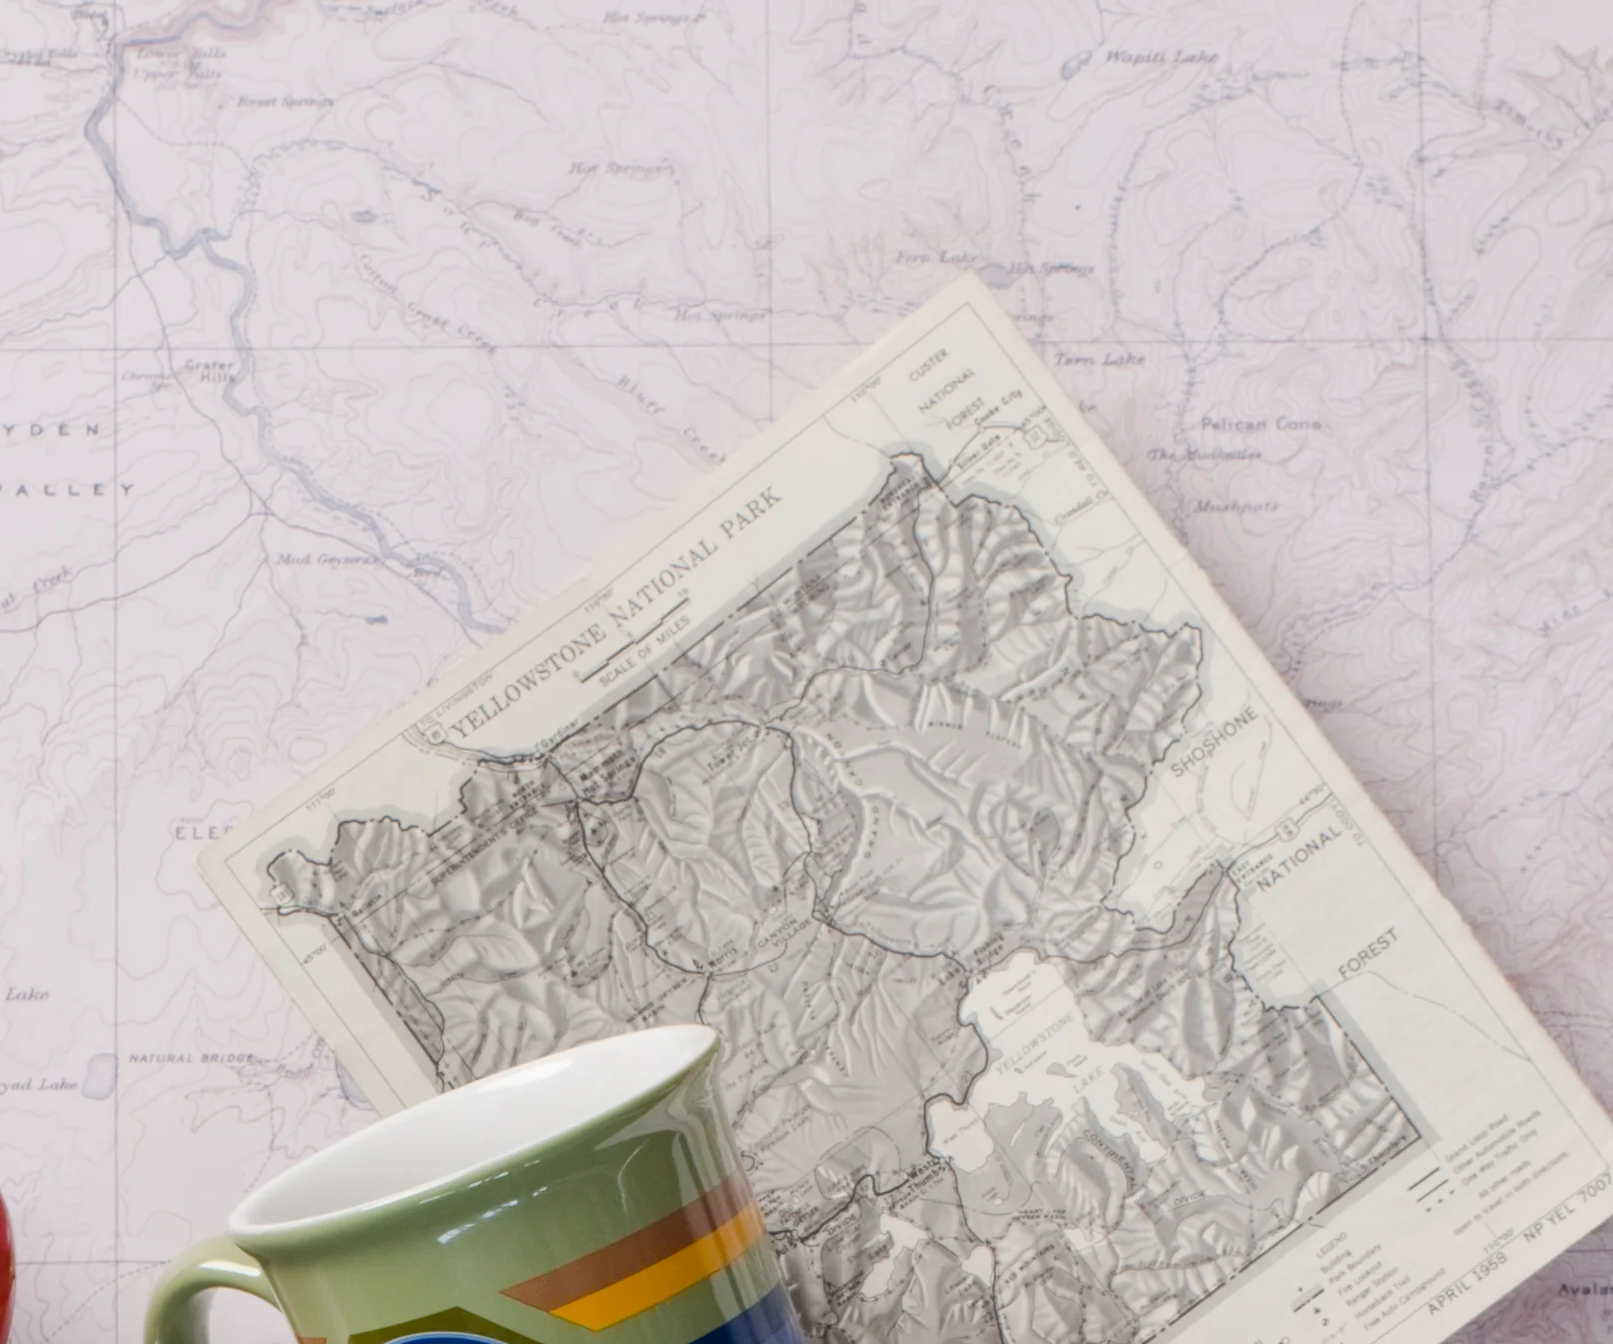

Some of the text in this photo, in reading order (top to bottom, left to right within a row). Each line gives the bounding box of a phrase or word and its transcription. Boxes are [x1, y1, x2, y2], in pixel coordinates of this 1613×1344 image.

[908, 348, 948, 383] CUSTER
[918, 368, 976, 414] NATIONAL
[946, 397, 985, 431] FOREST
[448, 485, 782, 741] YELLOWSTONE NATIONAL PARK
[1171, 706, 1258, 778] SHOSHONE
[1256, 825, 1343, 892] NATIONAL
[1338, 927, 1399, 980] FOREST
[5, 987, 50, 1001] Lake
[129, 1053, 193, 1064] NATURAL
[1523, 1172, 1613, 1244] NP YEL 7007
[1427, 1251, 1509, 1317] APRIL 1958
